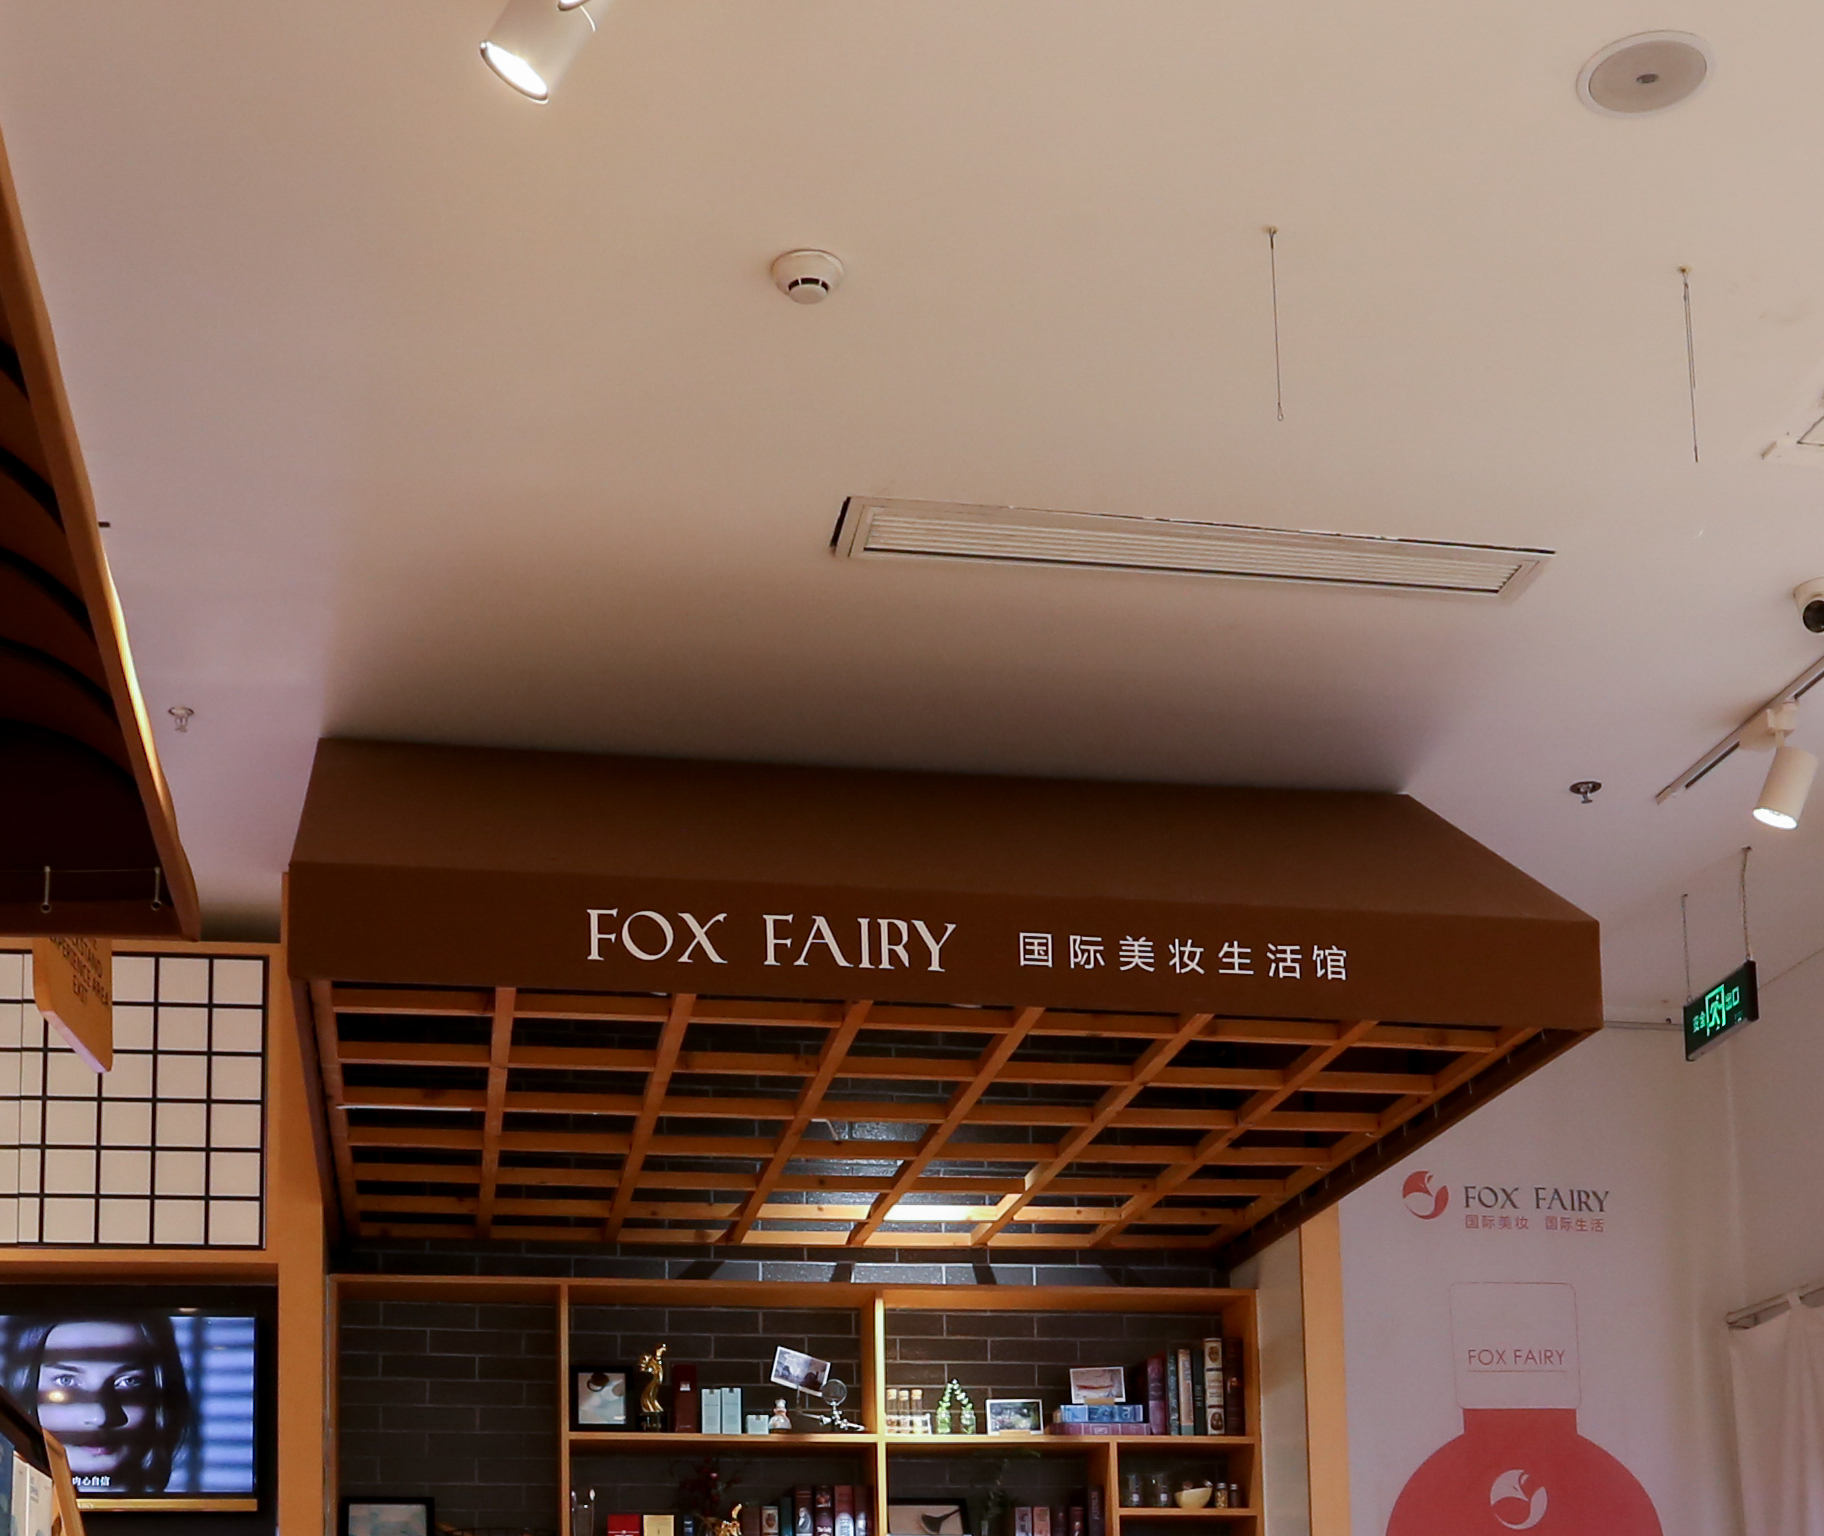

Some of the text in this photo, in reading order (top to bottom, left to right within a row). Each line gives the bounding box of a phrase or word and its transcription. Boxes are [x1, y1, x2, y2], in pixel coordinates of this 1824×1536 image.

[586, 908, 958, 973] FOX FAIRY
[1018, 931, 1348, 982] 国际美妆生活馆
[1463, 1186, 1610, 1214] FOX FAIRY
[1464, 1215, 1606, 1234] 国际美妆 国际生活
[1468, 1349, 1566, 1367] FOX FAIRY
